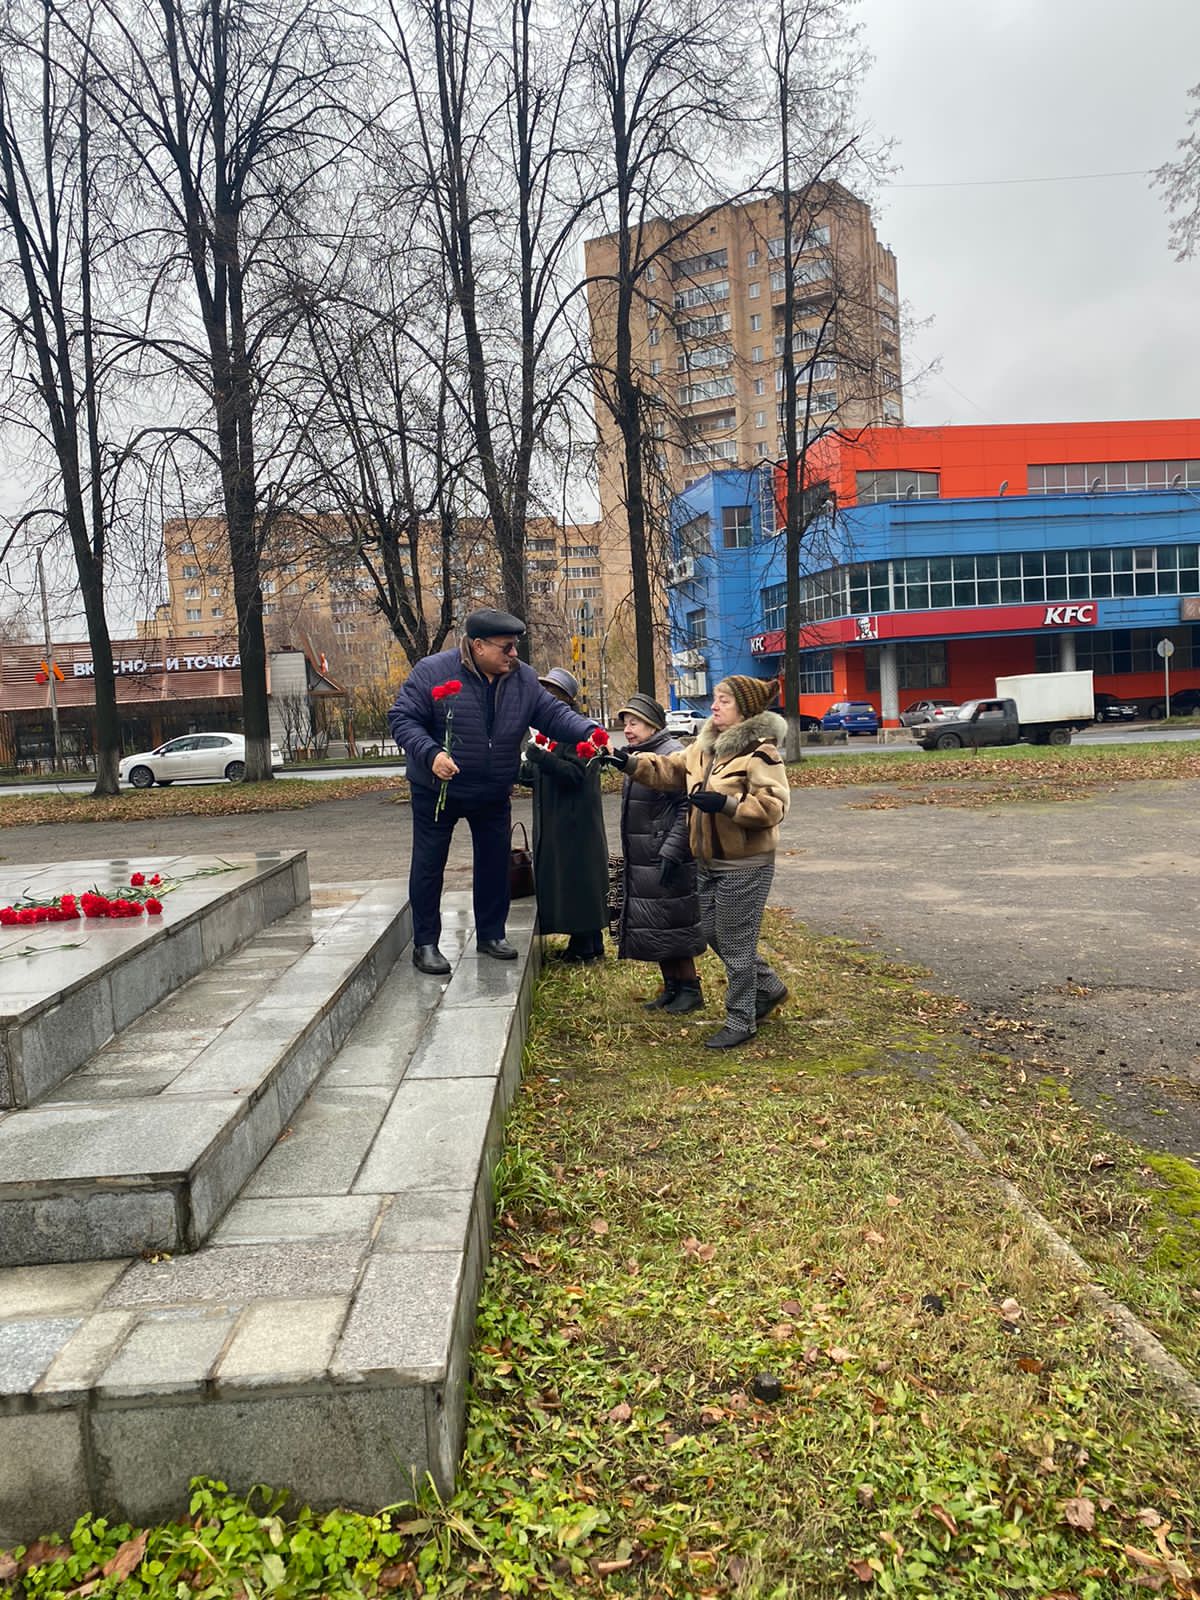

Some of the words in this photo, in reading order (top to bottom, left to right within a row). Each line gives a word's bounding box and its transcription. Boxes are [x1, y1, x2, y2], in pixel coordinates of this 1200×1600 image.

[1043, 605, 1094, 625] KFC
[751, 636, 765, 653] KFC
[73, 660, 145, 676] ВКСНО
[166, 656, 179, 671] И
[183, 654, 241, 670] ТОЧКА
